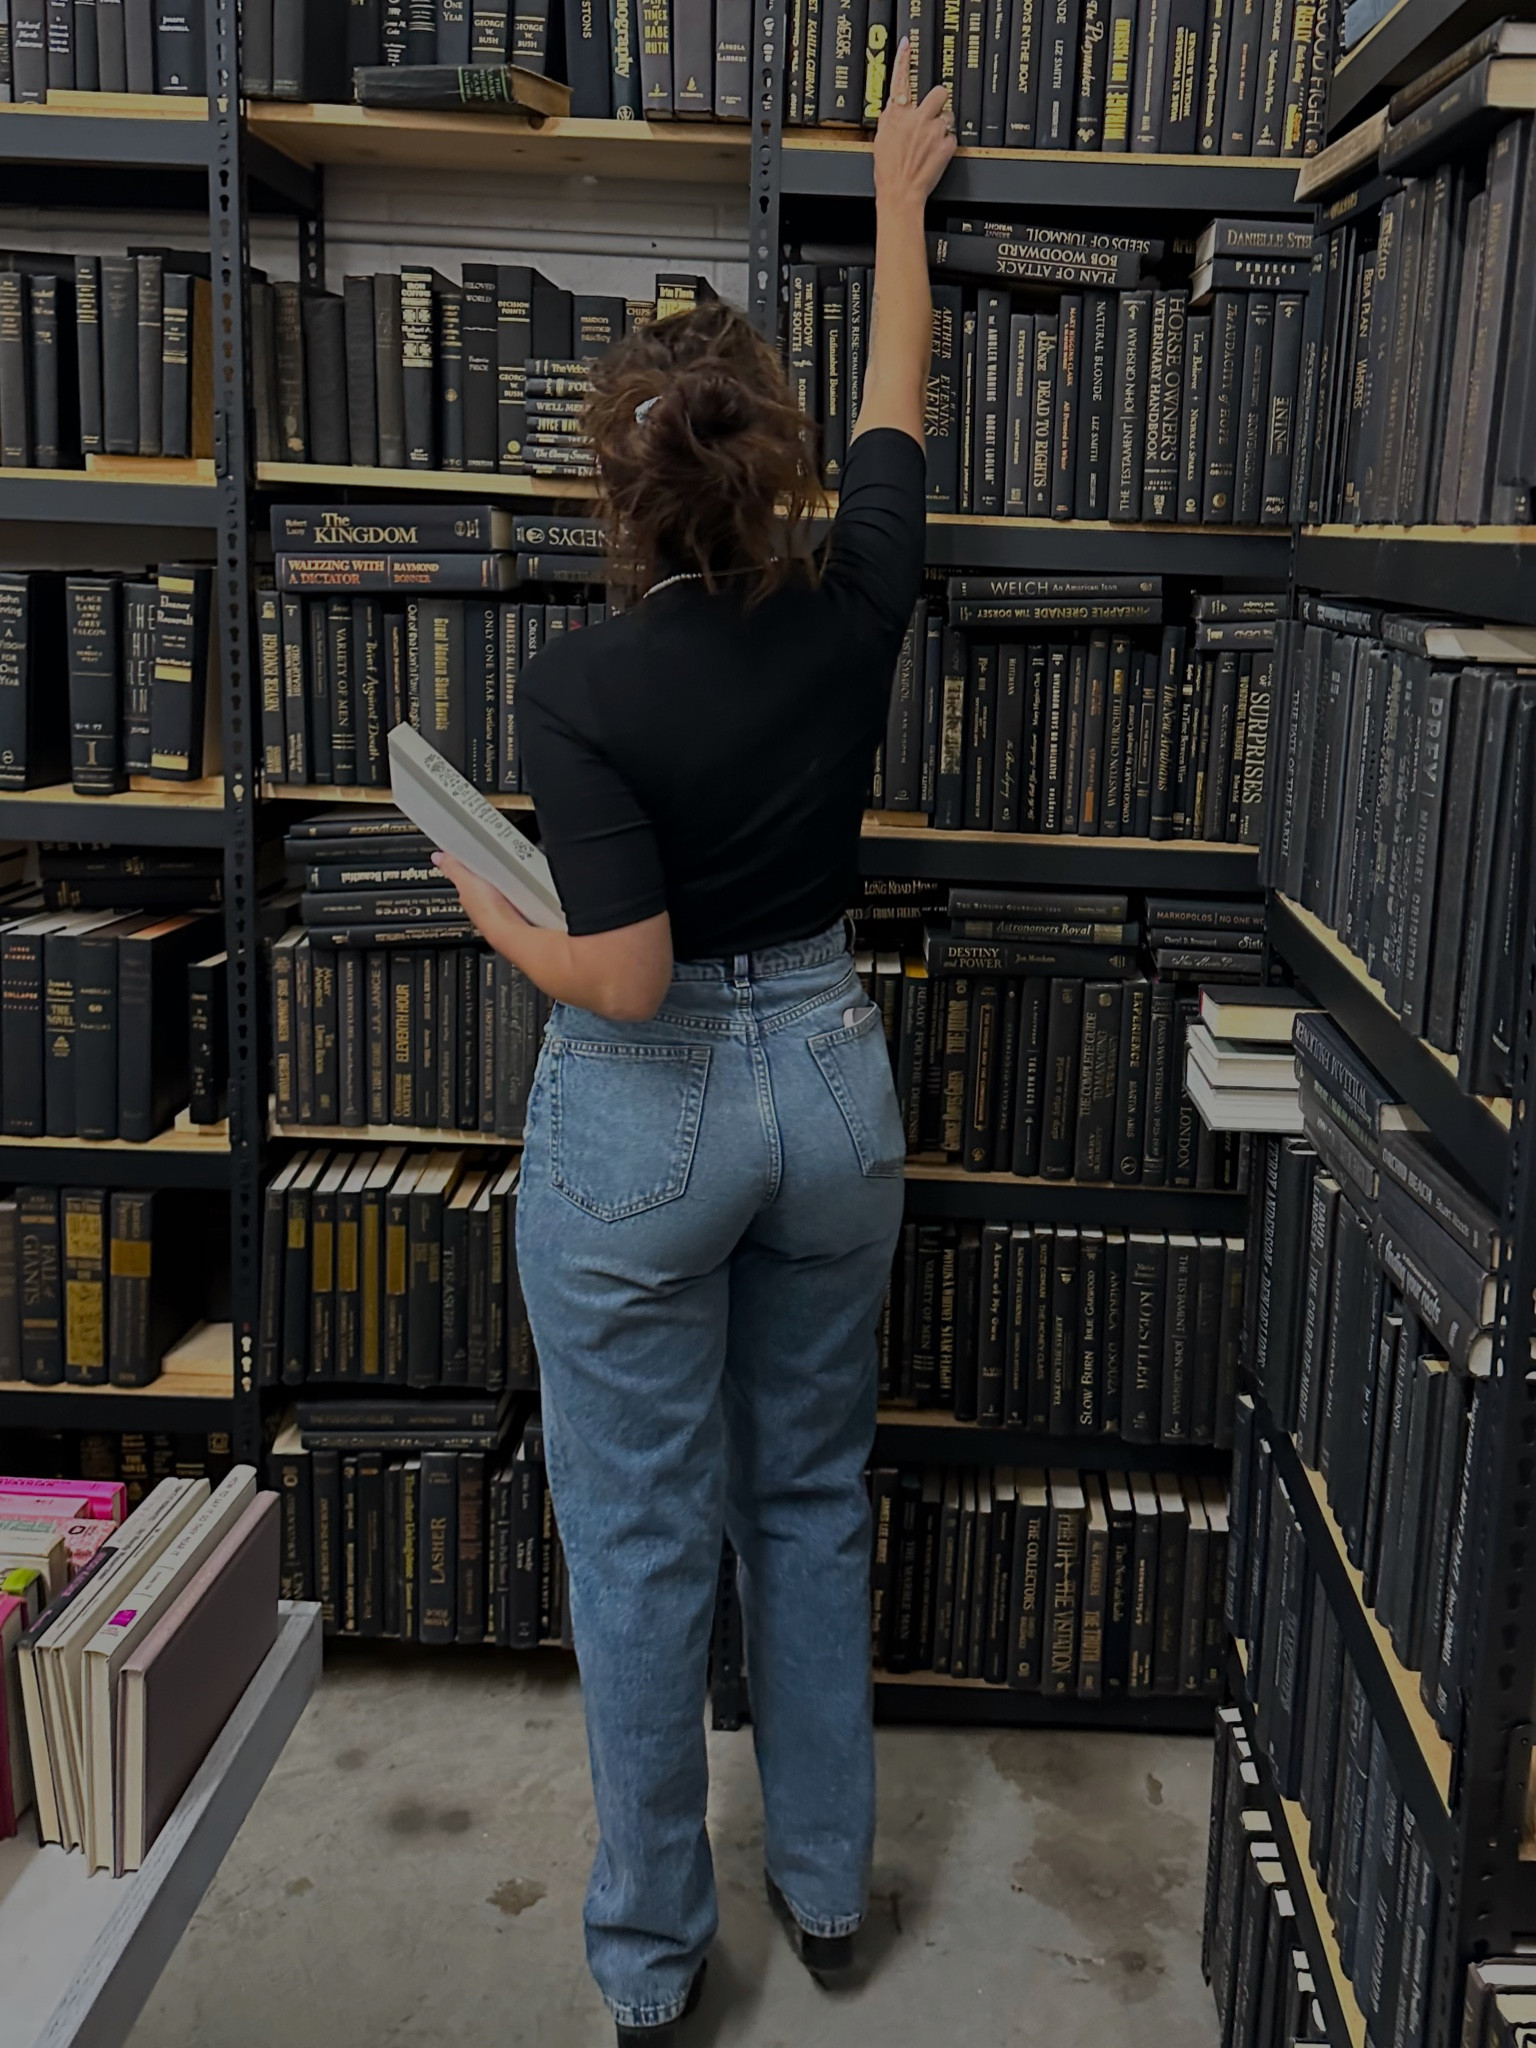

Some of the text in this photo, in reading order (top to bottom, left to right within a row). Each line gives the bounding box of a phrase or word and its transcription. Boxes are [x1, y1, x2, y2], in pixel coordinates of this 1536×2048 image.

[474, 19, 504, 28] GEORGE
[514, 23, 543, 32] GEORGE
[644, 41, 668, 54] RUTH
[836, 14, 846, 59] TREASON
[805, 19, 817, 98] KAHLIL GIBRAN
[1052, 40, 1064, 88] LIZ SMITH
[998, 243, 1118, 267] BOB WOODWARD
[1026, 227, 1150, 252] SEEDS OF TURMOIL
[1227, 229, 1313, 248] DANIELLE STE
[996, 261, 1117, 285] PLAN OF ATTACK
[1235, 261, 1296, 275] PERFECT
[1361, 267, 1374, 300] BELVA
[803, 301, 813, 347] WIDOW
[941, 306, 953, 359] ARTHUR
[1226, 303, 1238, 323] The
[1359, 302, 1372, 337] PLAIN
[1066, 307, 1077, 386] MARY HIGGINS CLARK
[1221, 324, 1236, 389] AUDACITY
[797, 379, 806, 413] ROBERT
[828, 329, 839, 416] Unfinished Business
[1089, 301, 1106, 462] NATURAL BLONDE LIZ SMITH
[1146, 298, 1165, 461] VETERINARY HANDBOOK
[1160, 298, 1184, 462] HORSE OWNER'S
[924, 376, 939, 437] NEWS
[939, 374, 951, 437] EVENING
[1119, 327, 1137, 511] THE TESTAMENT JOHN GRISHAM
[1187, 331, 1204, 480] True Believer NICHOLAS SPARKS
[1218, 408, 1231, 445] HOPE
[1033, 380, 1052, 487] DEAD TO RIGHTS
[314, 526, 418, 544] KINGDOM
[322, 512, 349, 527] The
[289, 560, 384, 572] WALTZING WITH
[393, 562, 439, 572] RAYMOND
[990, 581, 1117, 595] WELCH An American Icon
[75, 595, 102, 603] BLACK
[157, 612, 193, 626] Roosevelt
[160, 595, 191, 610] Eleanor
[73, 628, 106, 636] FALCON
[262, 634, 280, 712] NEVER ENOUGH
[336, 628, 349, 727] VARIETY OF MEN
[362, 640, 381, 761] Brief Against Death
[1233, 676, 1250, 760] WONDERFUL TENNESSEE
[1107, 699, 1122, 807] WINSTON CHURCHILL
[1157, 684, 1178, 791] The New Arabians
[1242, 692, 1271, 804] SURPRISES
[1121, 766, 1132, 823] CONGO DIARY
[1281, 690, 1300, 857] THE FATE OF THE EARTH
[1405, 696, 1444, 981] PREY MICHAEL CRICHTON
[375, 906, 421, 917] Cures
[996, 920, 1093, 938] Astronomers Royal
[1156, 911, 1250, 924] MARKOPOLOS NO ONE
[948, 947, 999, 958] DESTINY
[47, 1015, 75, 1026] NOVEL
[51, 1004, 71, 1015] THE
[908, 986, 928, 1143] READY FOR THE DEFENSE
[1126, 991, 1143, 1138] EXPERIENCE MARTIN AMIS
[1178, 1107, 1193, 1170] LONDON
[1266, 1140, 1280, 1188] TERRY
[1262, 1188, 1277, 1265] ANDERSON
[1310, 1184, 1321, 1252] LINDSEY
[1316, 1201, 1328, 1249] DAVID
[23, 1235, 40, 1305] GIANTS
[41, 1244, 56, 1282] FALL
[1135, 1291, 1155, 1390] KOESTLER
[1172, 1255, 1189, 1415] THE TESTAMENT JOHN GRISHAM
[1299, 1266, 1319, 1423] THE COLOR OF NIGHT
[429, 1516, 446, 1584] LASHER
[1023, 1517, 1041, 1610] THE COLLECTORS
[1051, 1611, 1075, 1674] VISITATION
[1085, 1611, 1100, 1628] THE
[1083, 1629, 1100, 1663] TRUTH
